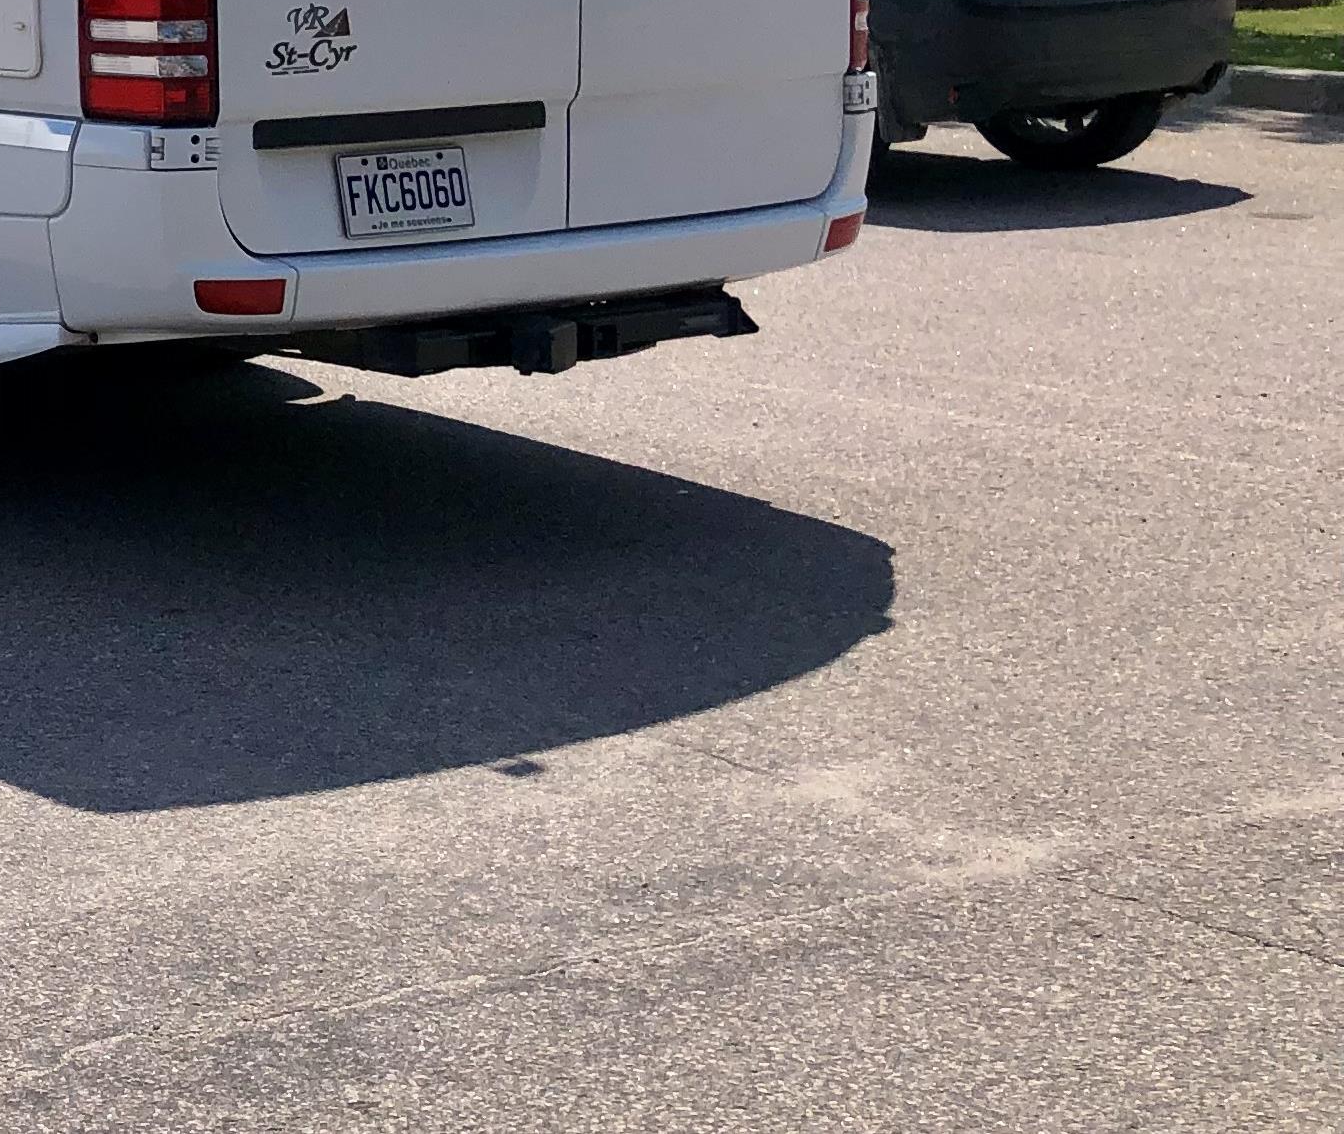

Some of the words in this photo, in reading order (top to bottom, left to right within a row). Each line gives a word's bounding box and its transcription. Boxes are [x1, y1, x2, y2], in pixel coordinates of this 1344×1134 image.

[287, 3, 334, 35] VR
[265, 39, 358, 70] St-Cyr
[347, 167, 466, 216] FKC6060
